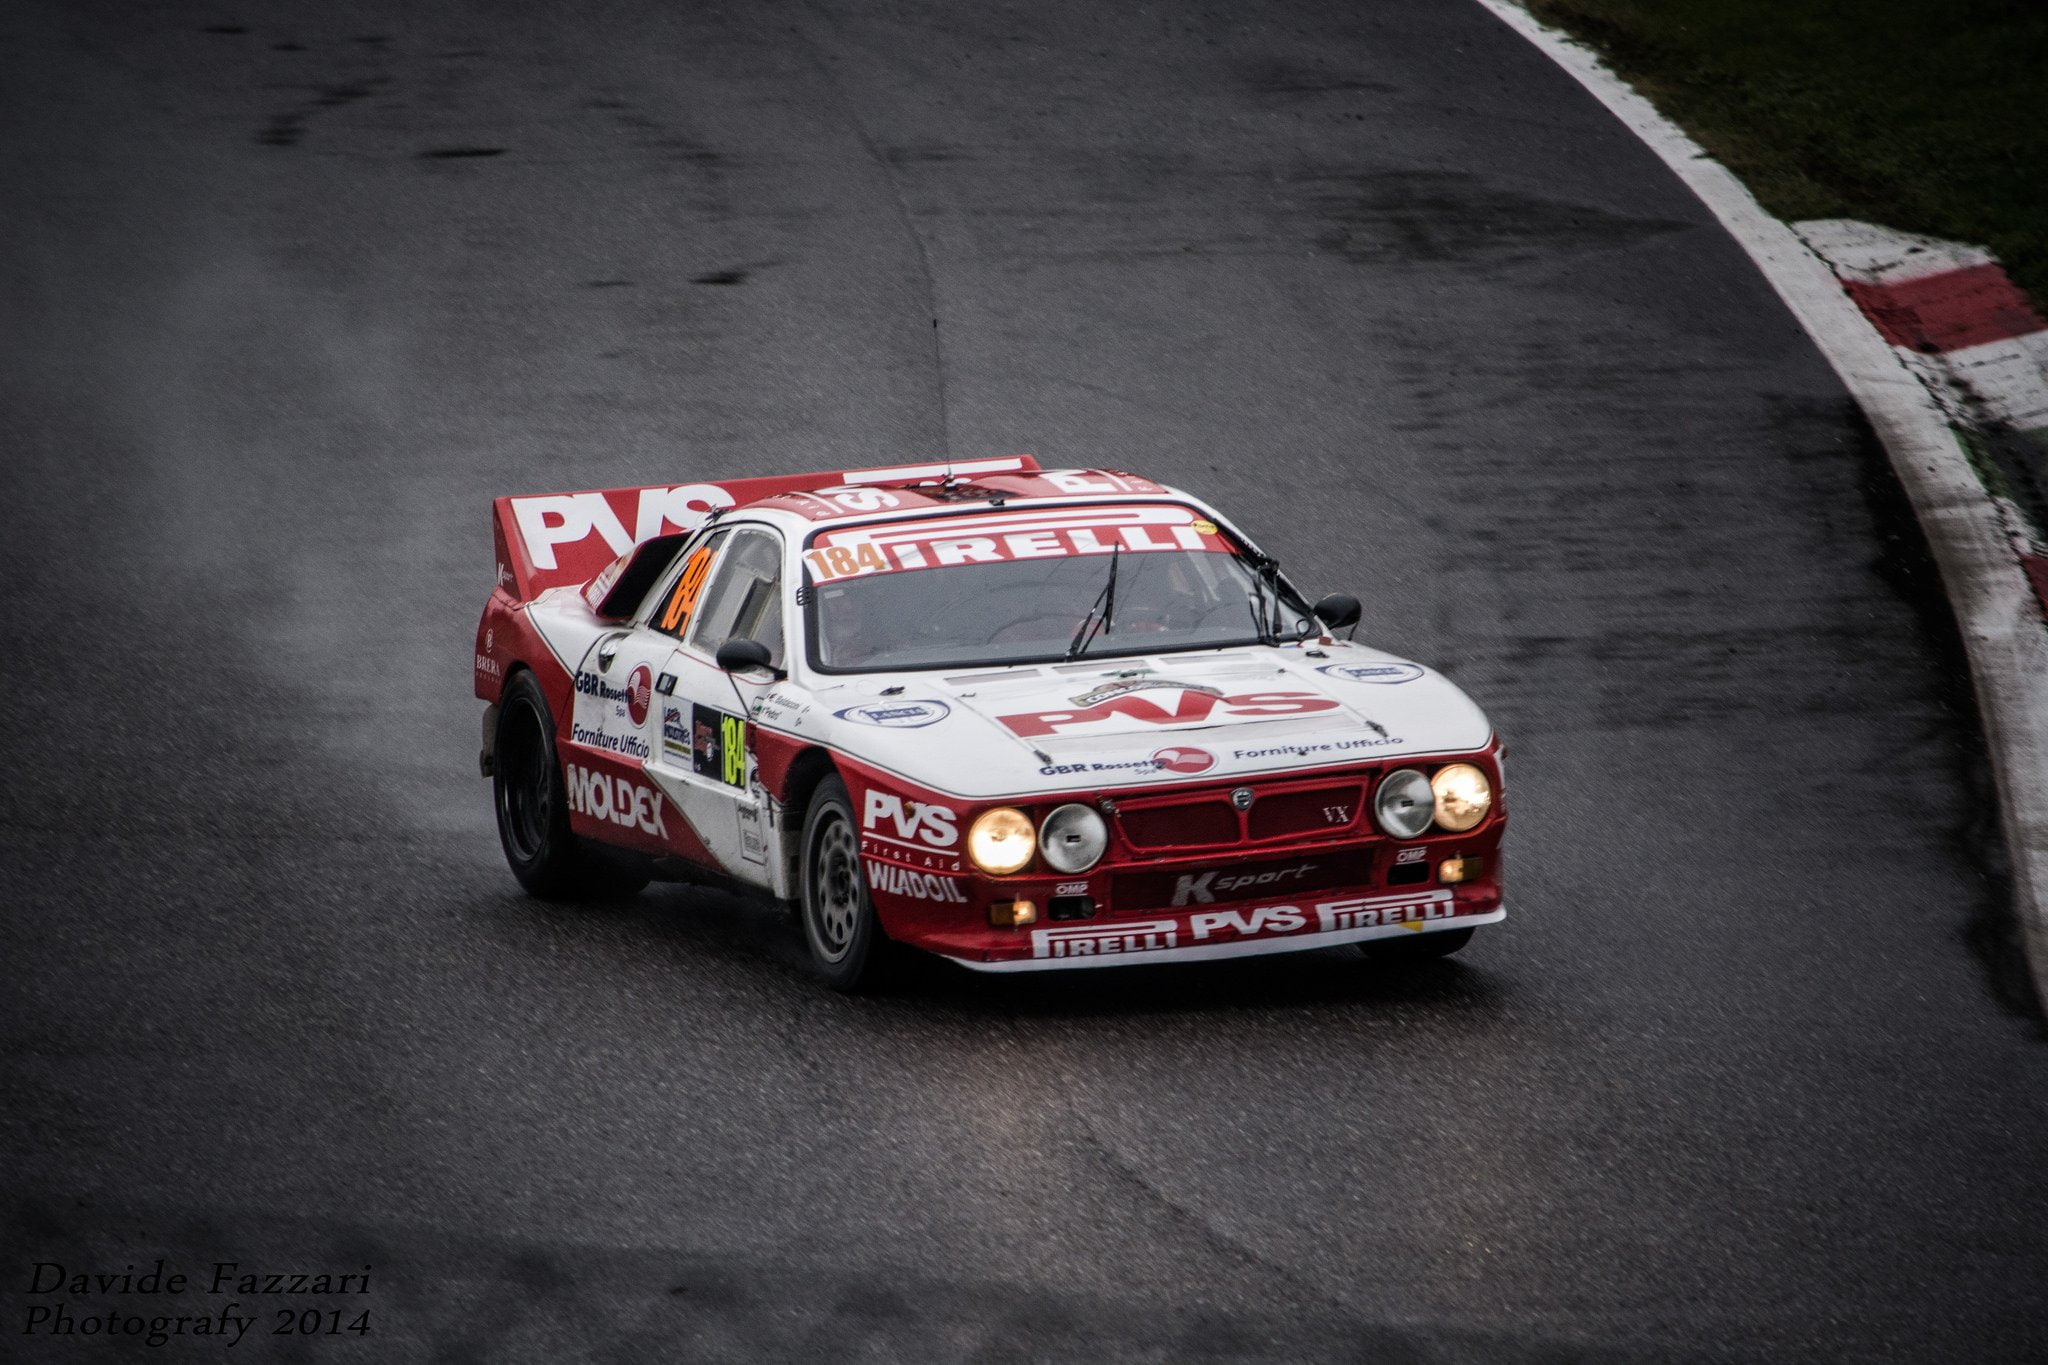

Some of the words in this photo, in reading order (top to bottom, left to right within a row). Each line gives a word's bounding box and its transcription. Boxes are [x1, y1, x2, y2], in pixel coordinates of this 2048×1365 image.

[511, 484, 736, 570] PVS
[827, 507, 1206, 569] PIRELLI
[805, 542, 885, 581] 184
[660, 544, 718, 637] 184
[575, 671, 599, 696] GBR
[996, 690, 1341, 735] PVS
[572, 723, 617, 750] Forniture
[620, 734, 650, 759] Ufficio
[722, 715, 745, 787] 184
[1234, 744, 1331, 759] Forniture
[1336, 737, 1404, 753] Ufficio
[1039, 764, 1088, 776] GBR
[567, 764, 669, 840] MOLDEX
[863, 788, 958, 846] PVS
[1323, 806, 1349, 823] VX
[861, 841, 911, 862] First
[923, 857, 960, 871] Aid
[1397, 850, 1427, 862] OMP
[867, 859, 968, 903] WLADOIL
[1055, 884, 1088, 895] OMP
[1031, 920, 1178, 958] PIRELLI
[1190, 905, 1307, 939] PVS
[1316, 889, 1455, 932] PIRELLI
